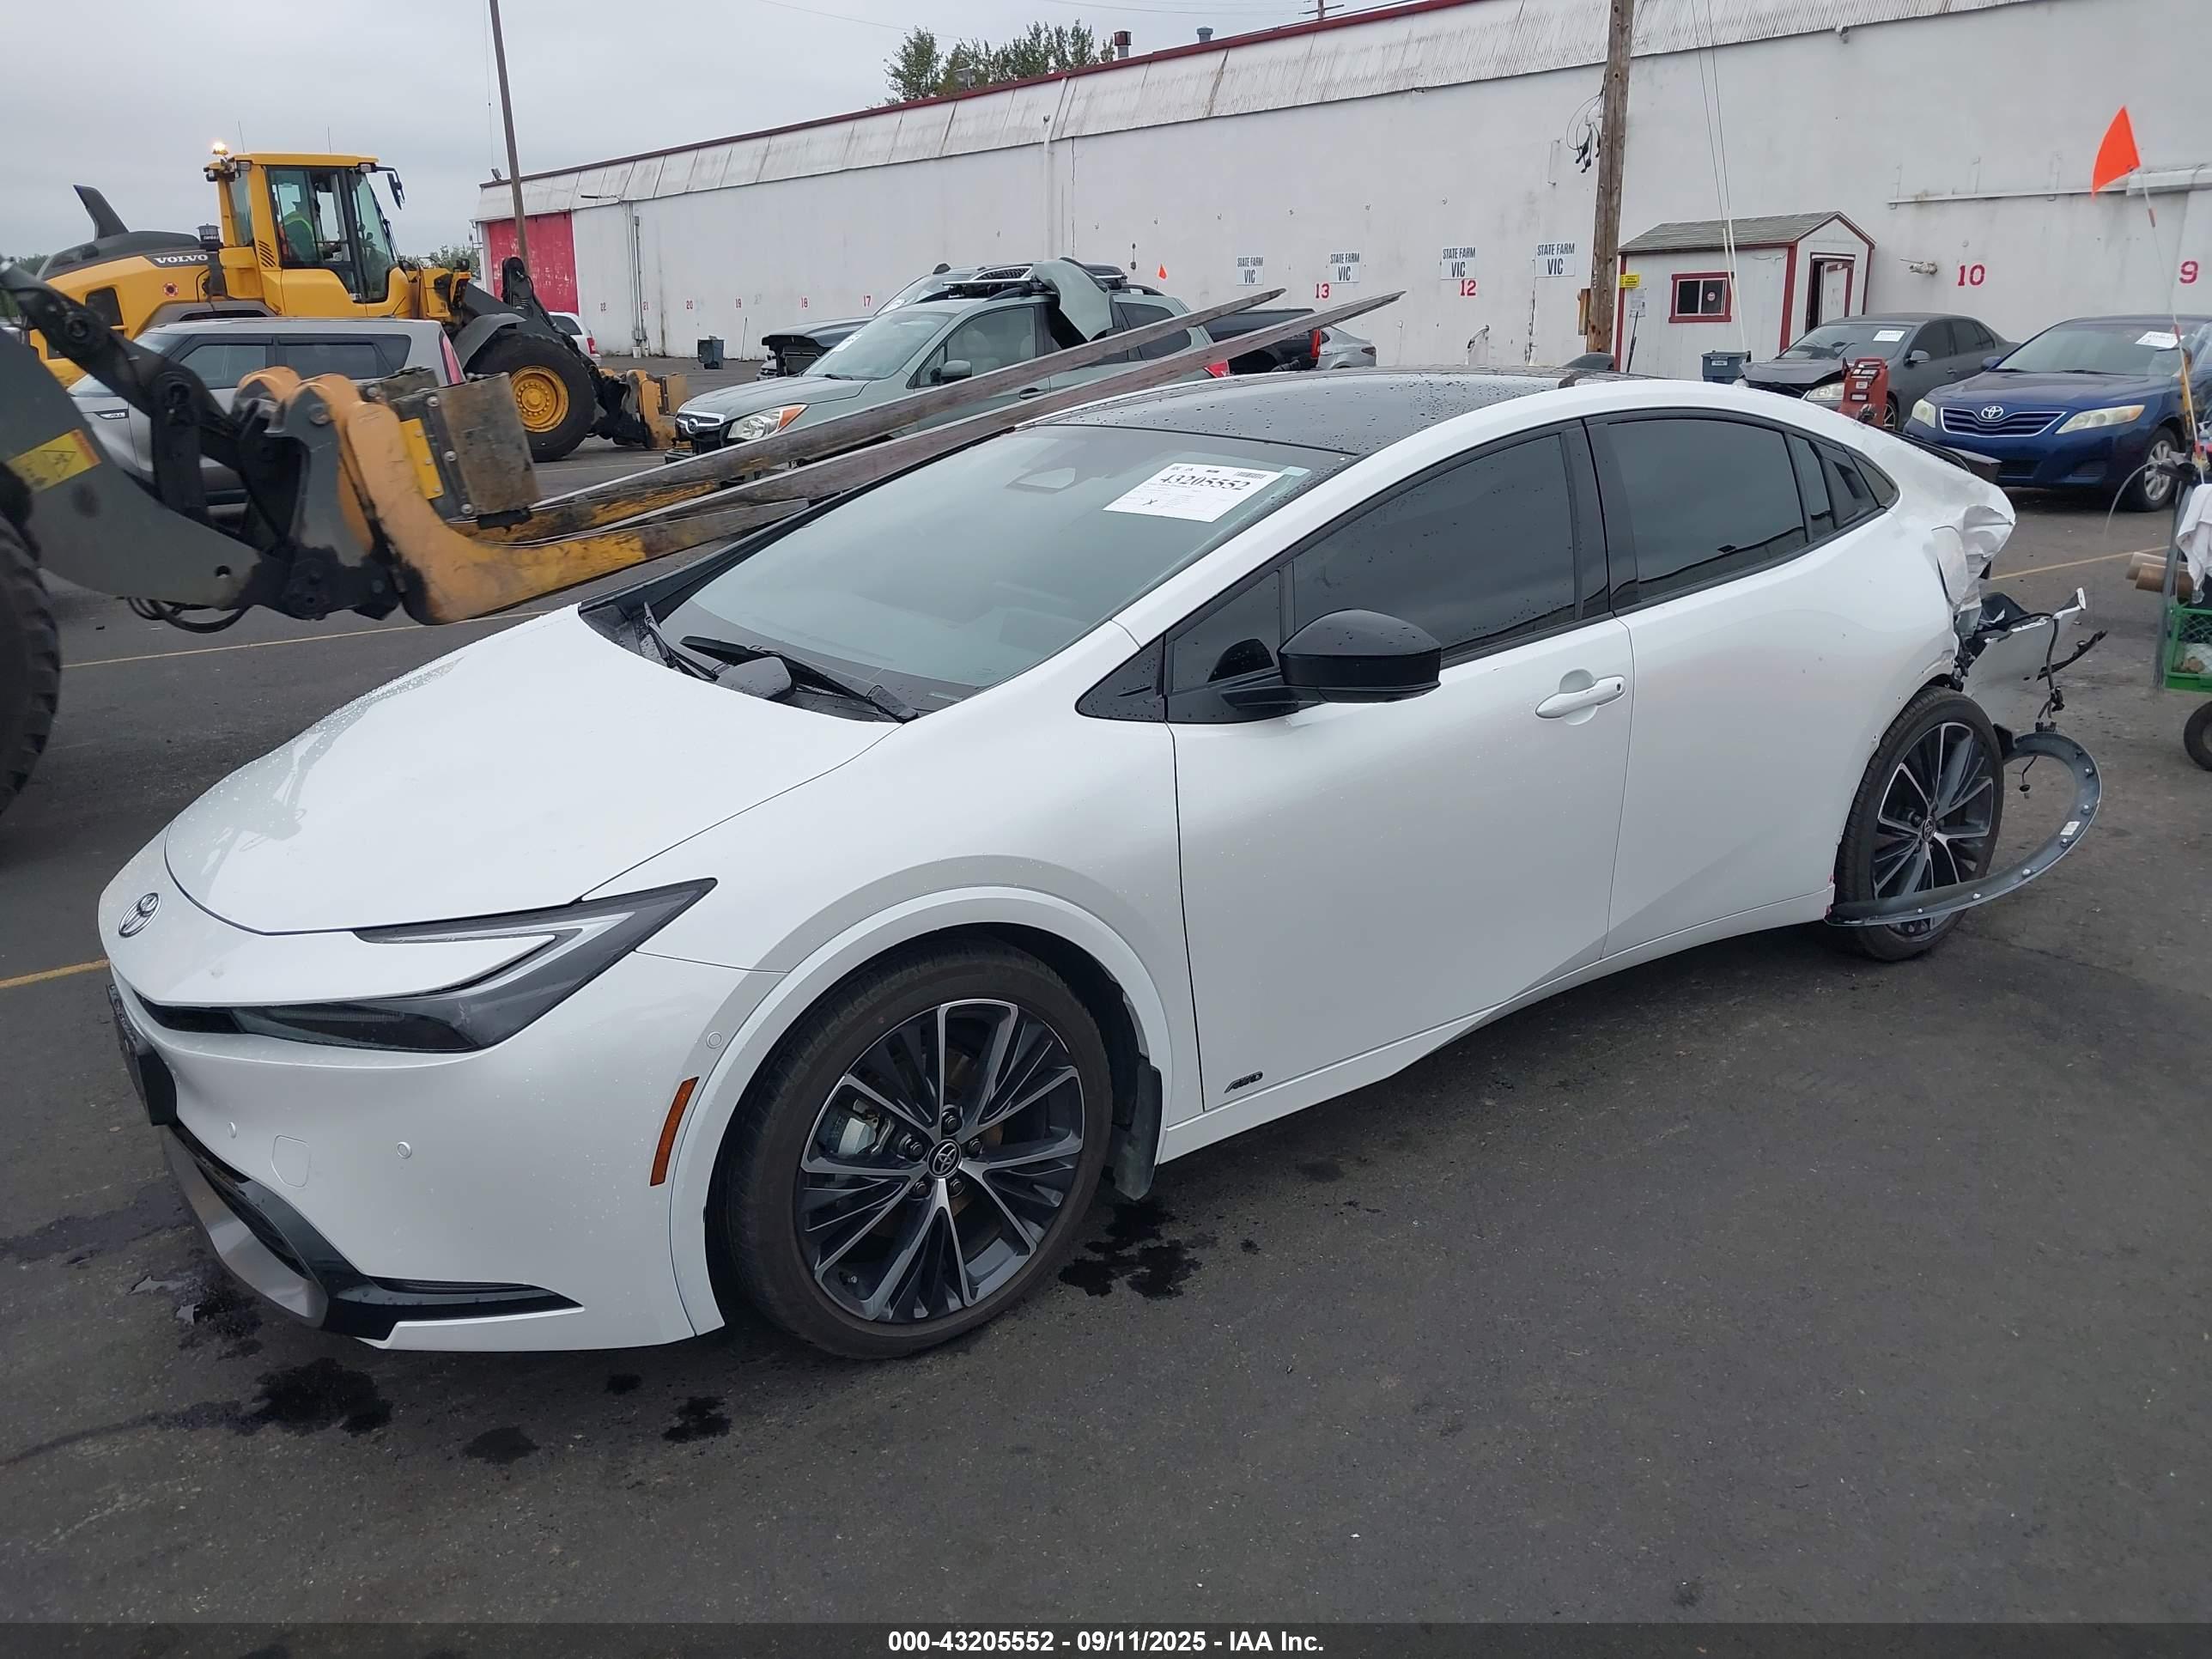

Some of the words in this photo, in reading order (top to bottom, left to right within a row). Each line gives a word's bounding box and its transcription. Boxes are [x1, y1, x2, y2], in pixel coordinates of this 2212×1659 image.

[1443, 248, 1458, 259] STATE
[1459, 247, 1476, 258] FARM
[1537, 244, 1555, 256] STATE
[1556, 242, 1575, 255] FARM
[154, 254, 208, 264] VOLVO
[1237, 257, 1249, 267] STATE
[1250, 257, 1264, 267] FARM
[1329, 253, 1345, 264] STATE
[1345, 252, 1360, 264] FARM
[1338, 265, 1351, 282] VIC
[1451, 261, 1466, 278] VIC
[1547, 258, 1564, 276] VIC
[2179, 260, 2198, 284] 9
[1243, 269, 1255, 283] VIC
[1957, 264, 1985, 286] 10
[1316, 283, 1330, 299] 13
[1460, 279, 1476, 296] 12
[686, 300, 693, 310] 20
[735, 298, 742, 308] 19
[800, 297, 808, 308] 18
[863, 295, 871, 307] 17
[1160, 473, 1251, 490] 43205552
